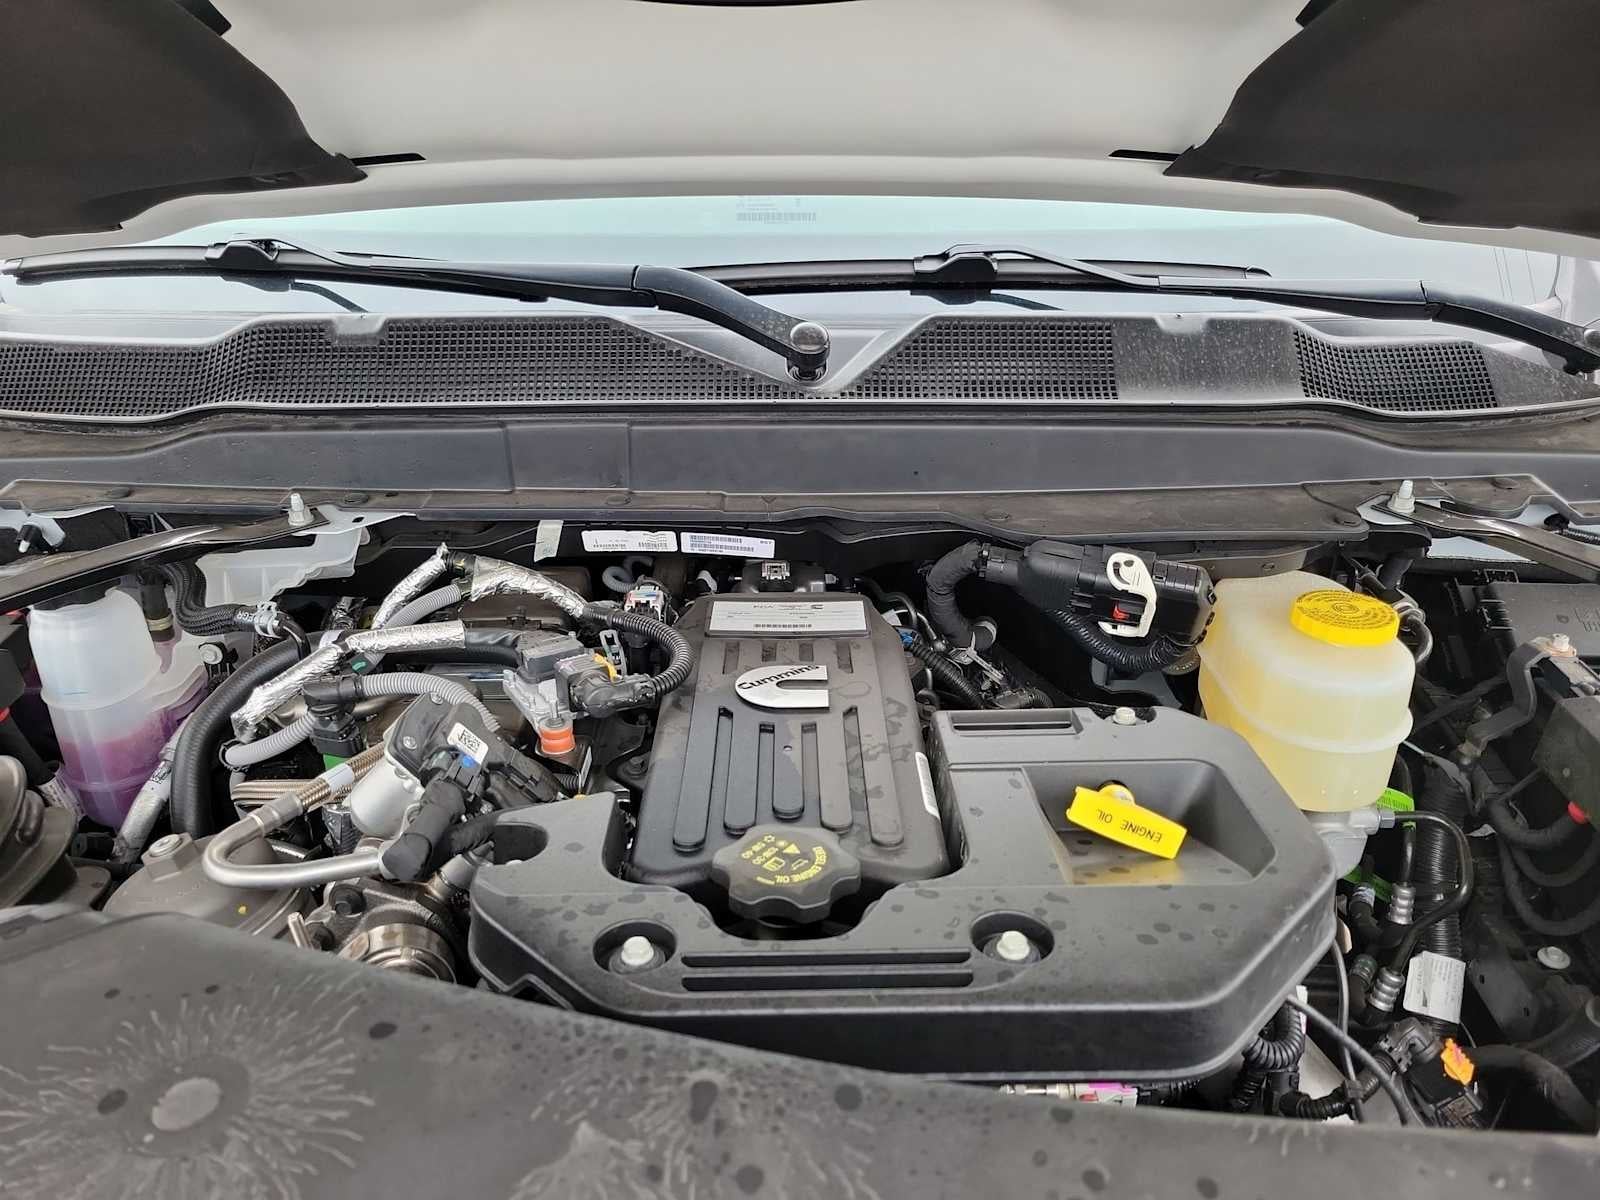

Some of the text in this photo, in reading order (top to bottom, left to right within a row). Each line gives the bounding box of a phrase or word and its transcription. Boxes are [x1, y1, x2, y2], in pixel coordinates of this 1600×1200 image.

[737, 665, 820, 690] Cummins
[1097, 809, 1162, 842] ENGINE OIL
[774, 874, 790, 884] OIL
